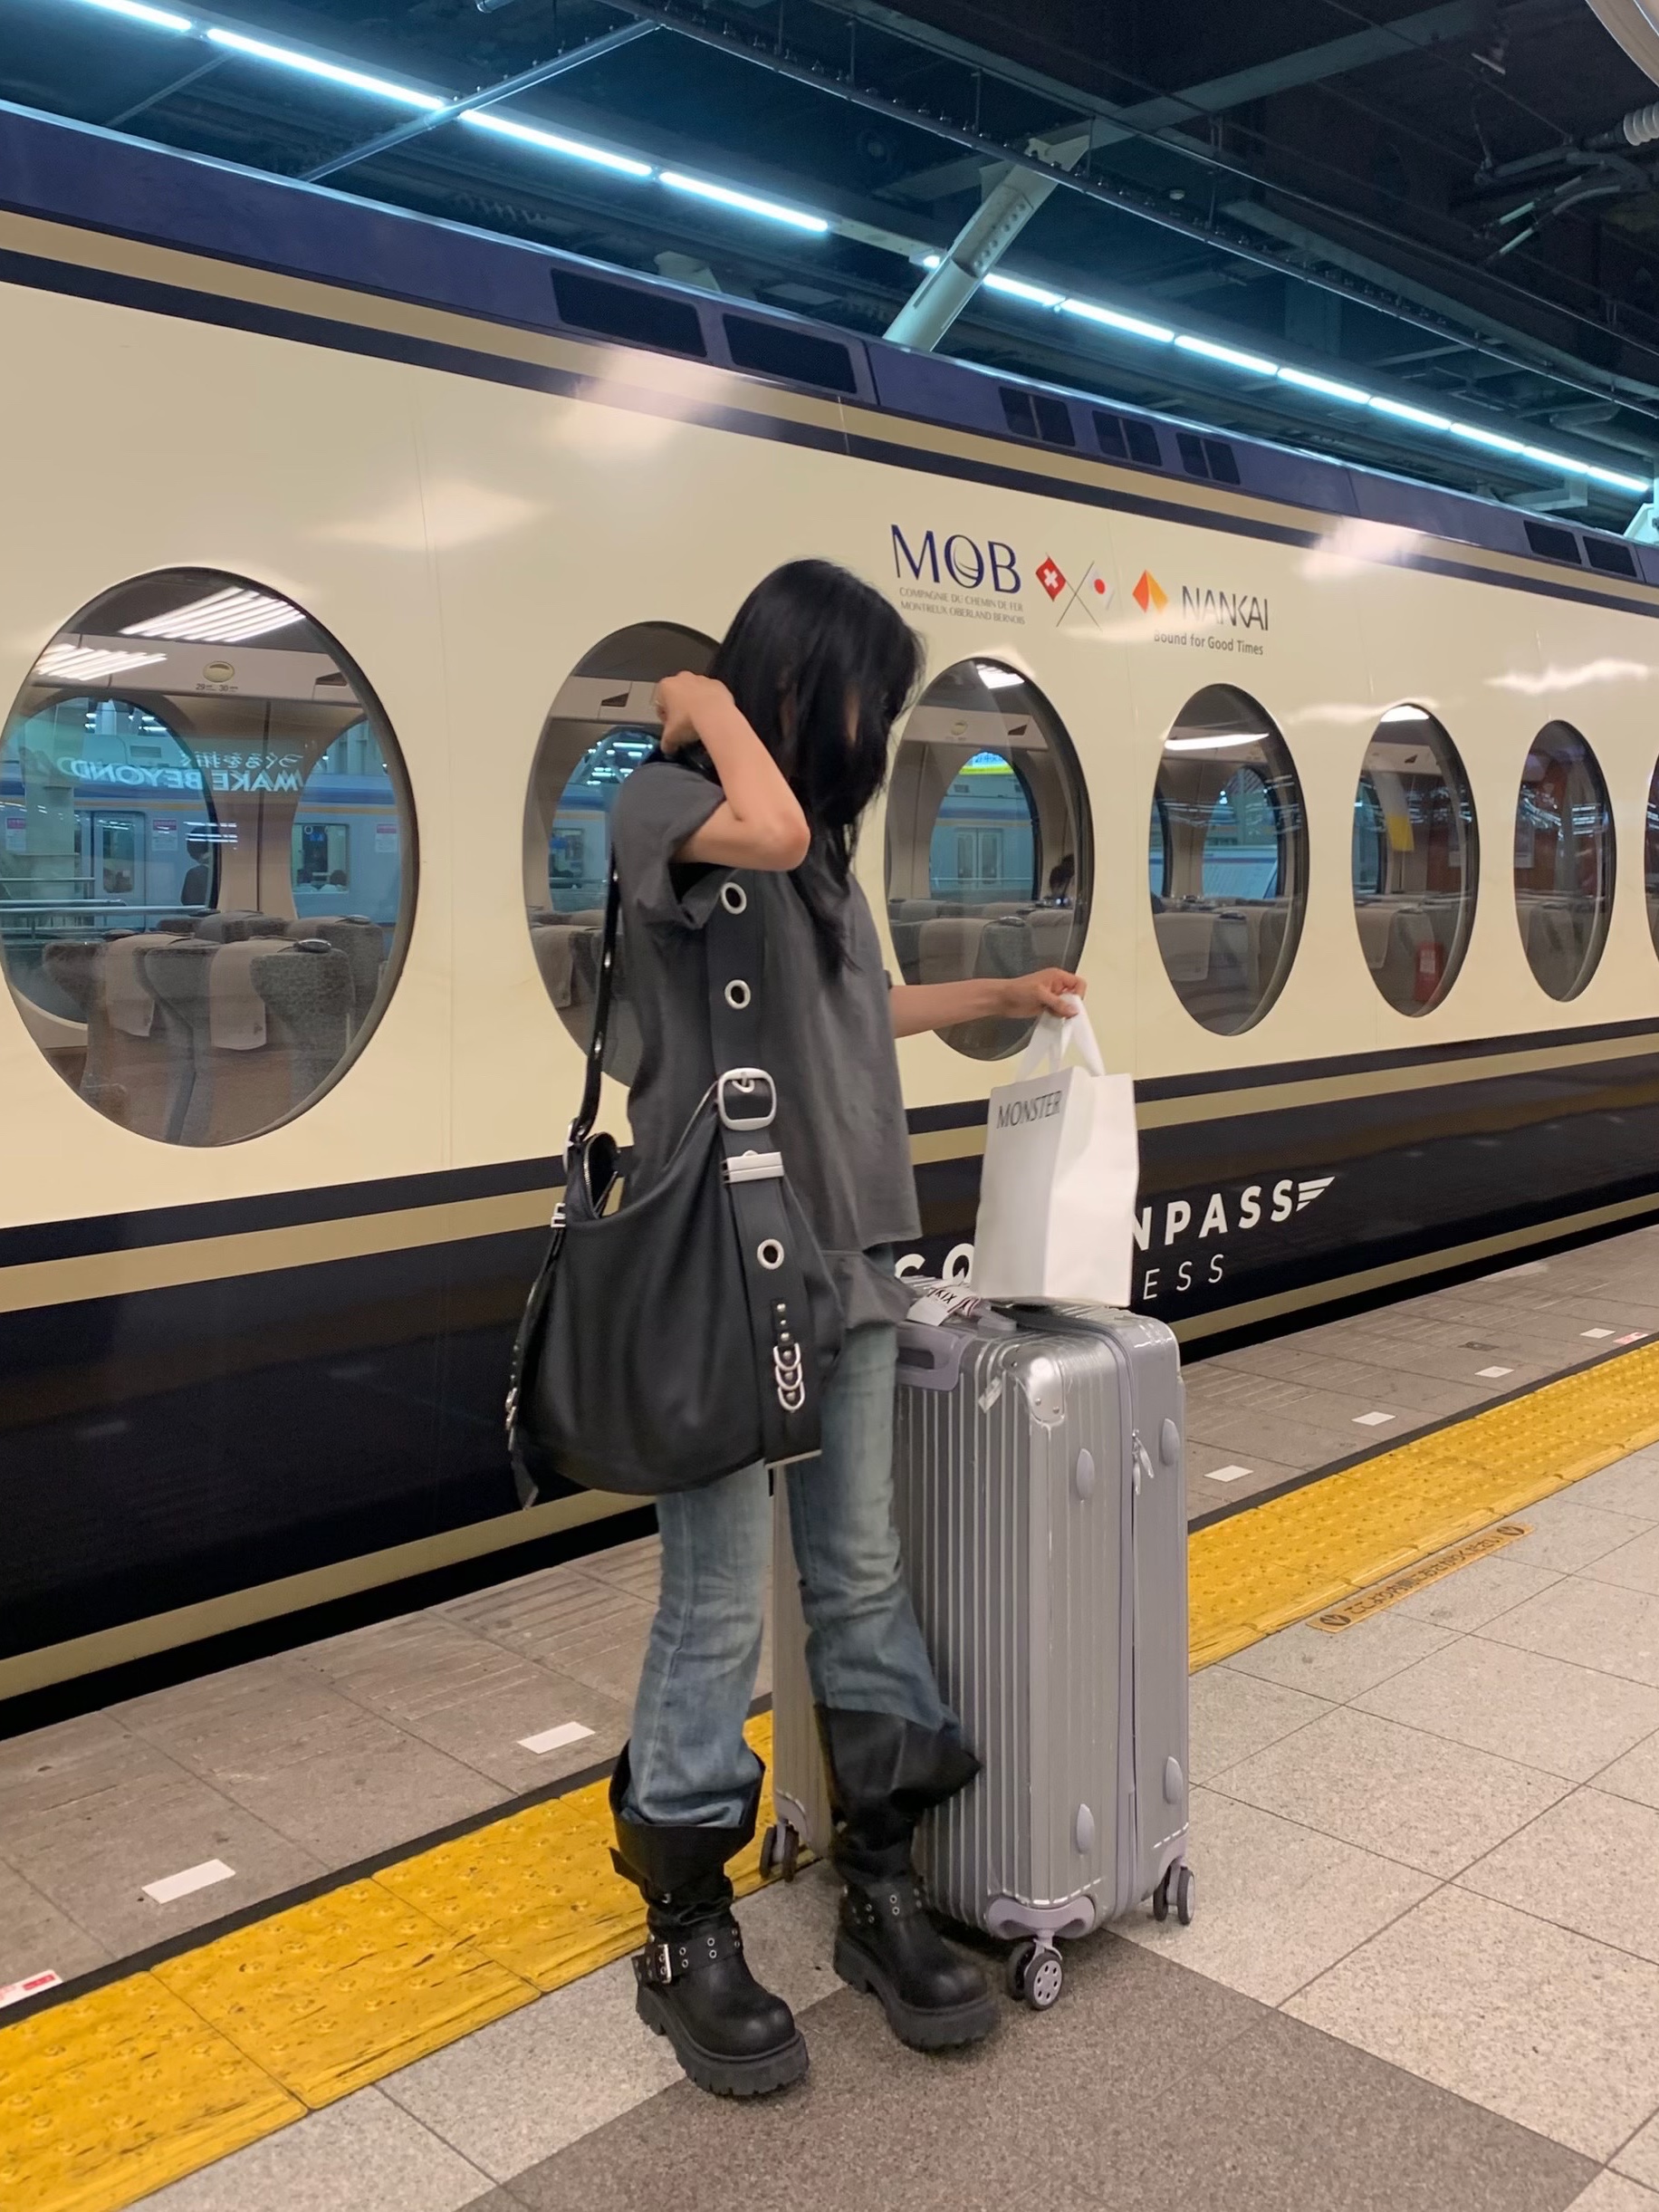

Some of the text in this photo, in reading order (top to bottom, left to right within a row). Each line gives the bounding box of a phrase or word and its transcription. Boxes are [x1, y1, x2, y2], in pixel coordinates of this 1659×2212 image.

[891, 524, 1021, 594] MOB
[949, 607, 992, 620] OBERLAND
[1182, 585, 1269, 631] NANKAI
[1154, 629, 1263, 656] Bound for Good Times
[996, 1090, 1061, 1130] MONSTER
